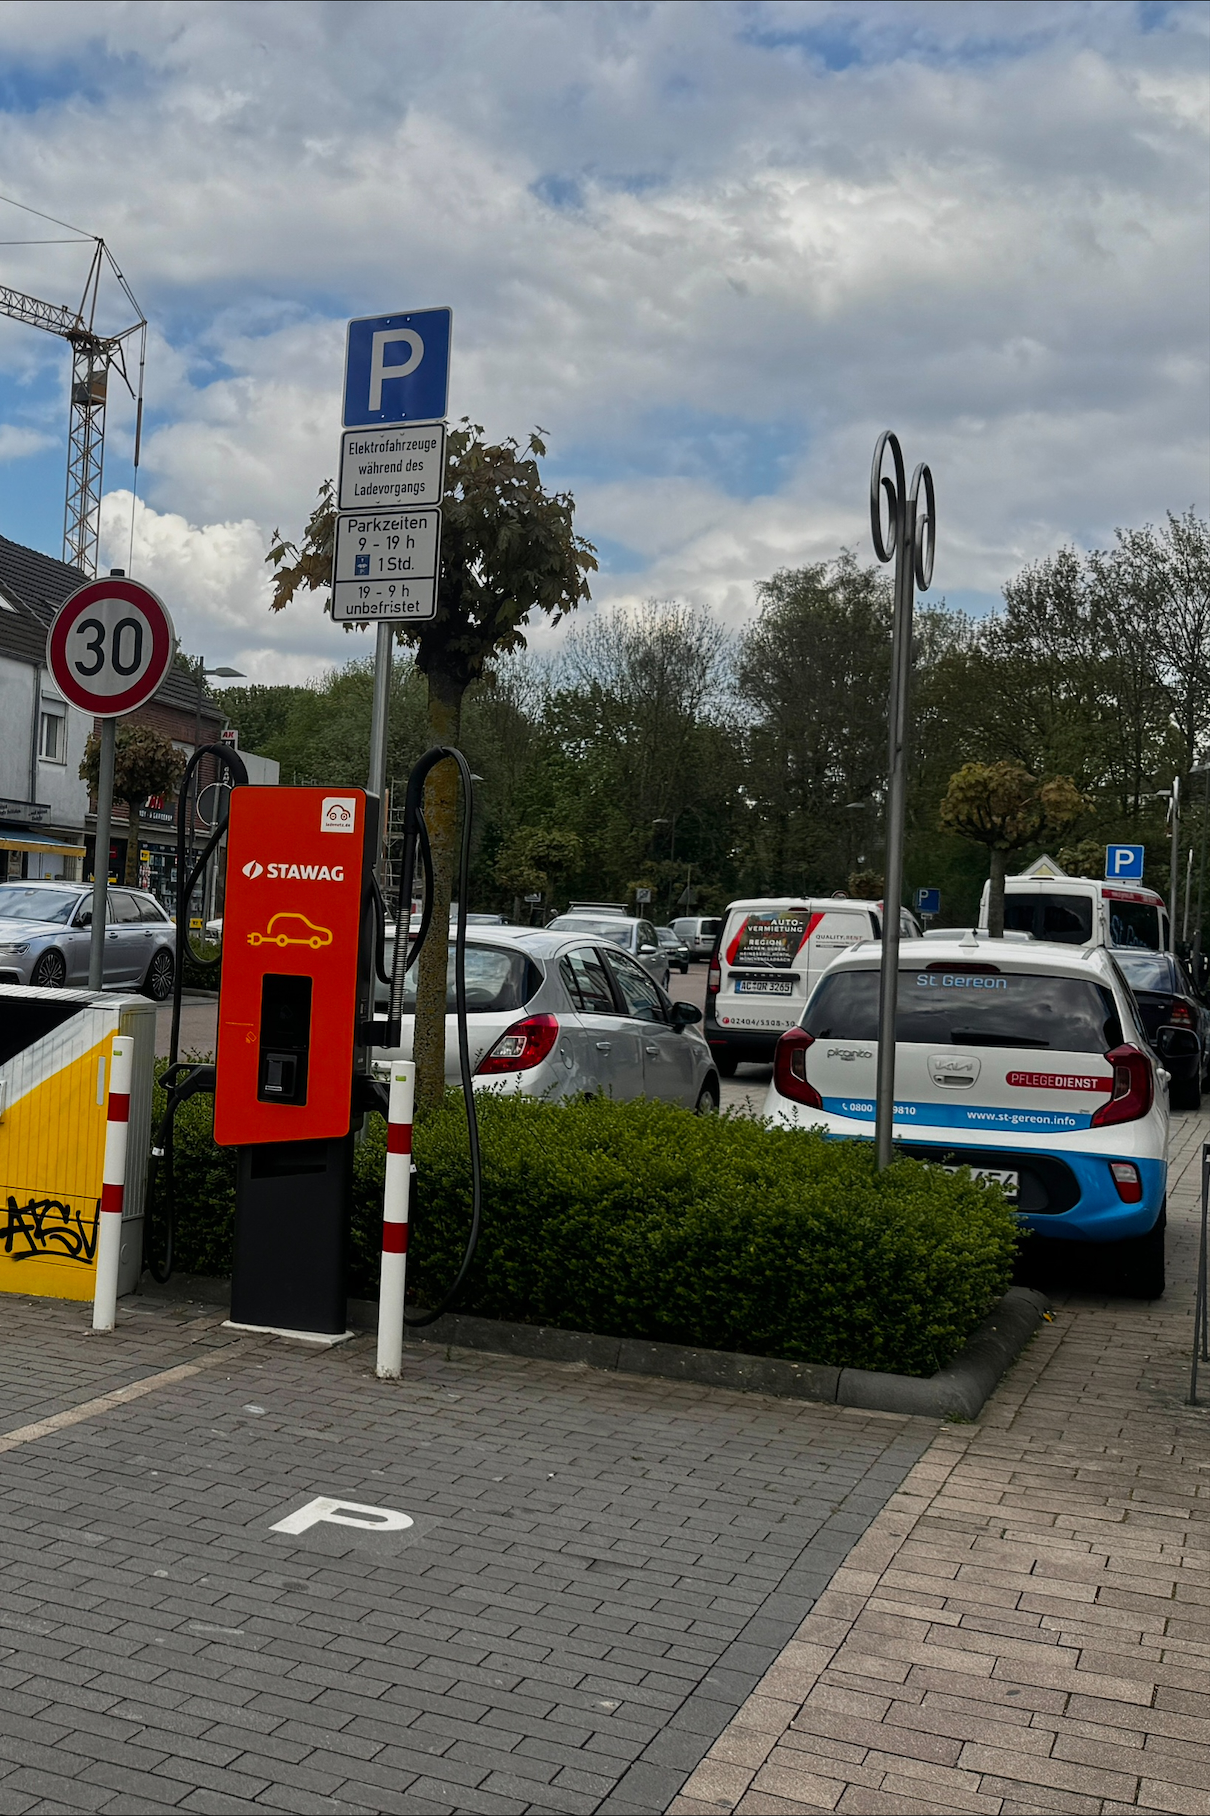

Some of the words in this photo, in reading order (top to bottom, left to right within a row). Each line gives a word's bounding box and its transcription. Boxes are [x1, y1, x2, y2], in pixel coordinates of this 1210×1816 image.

[368, 328, 425, 411] P
[349, 438, 437, 455] Elektrofahrzeuge
[358, 459, 403, 475] während
[405, 459, 424, 472] des
[354, 480, 426, 497] Ladevorgangs
[348, 516, 427, 533] Parkzeiten
[358, 537, 367, 551] 9
[386, 535, 400, 550] 19
[406, 535, 415, 549] h
[378, 557, 383, 571] 1
[387, 556, 415, 571] Std.
[358, 586, 371, 599] 19
[388, 585, 396, 597] 9
[402, 584, 410, 597] h
[346, 600, 420, 615] unbefristet
[75, 617, 143, 676] 30
[222, 731, 235, 739] AK
[1114, 849, 1134, 874] P
[267, 863, 345, 882] STAWAG
[918, 889, 929, 907] P
[741, 981, 752, 991] AC
[769, 982, 790, 992] 3265
[916, 974, 938, 986] St
[942, 974, 1007, 989] Gereon
[827, 1048, 873, 1059] picanto
[1011, 1073, 1098, 1089] PFLEGEDIENST
[849, 1103, 873, 1112] 0800
[966, 1111, 1076, 1126] www.st-gereon.info
[268, 1496, 414, 1535] P
